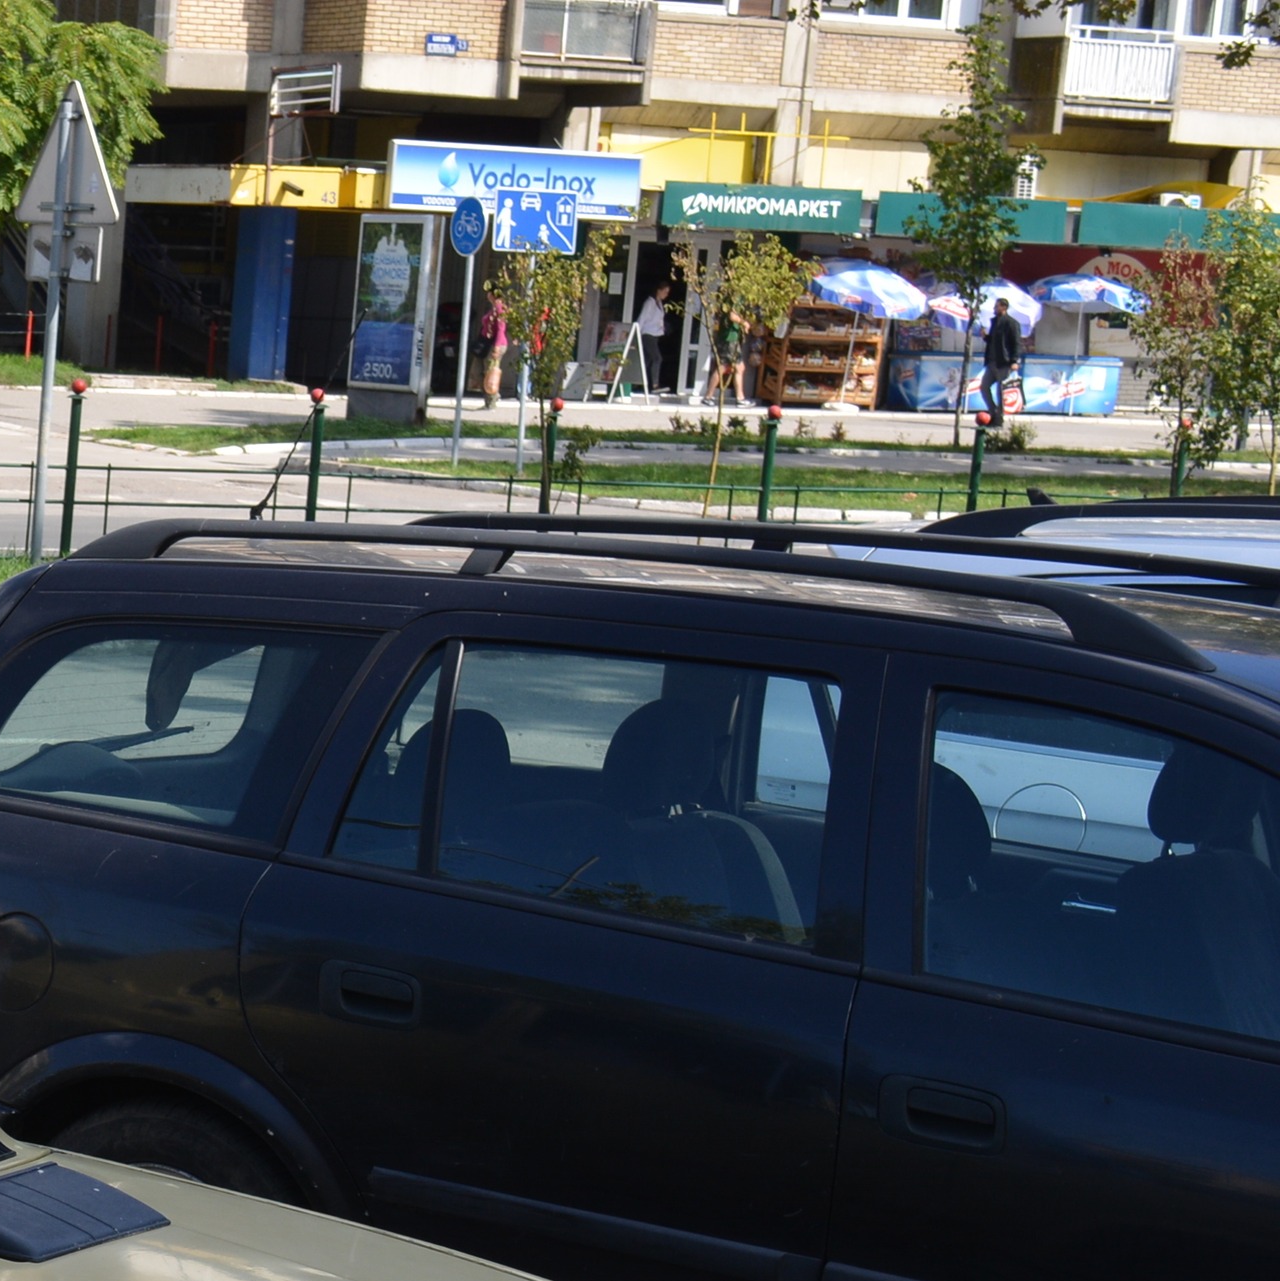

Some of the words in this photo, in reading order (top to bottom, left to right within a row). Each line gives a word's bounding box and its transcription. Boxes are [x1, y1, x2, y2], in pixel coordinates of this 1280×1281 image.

[468, 162, 596, 195] Vodo-Inox
[321, 192, 337, 204] 43
[707, 194, 842, 218] МИКРОМАРКЕТ
